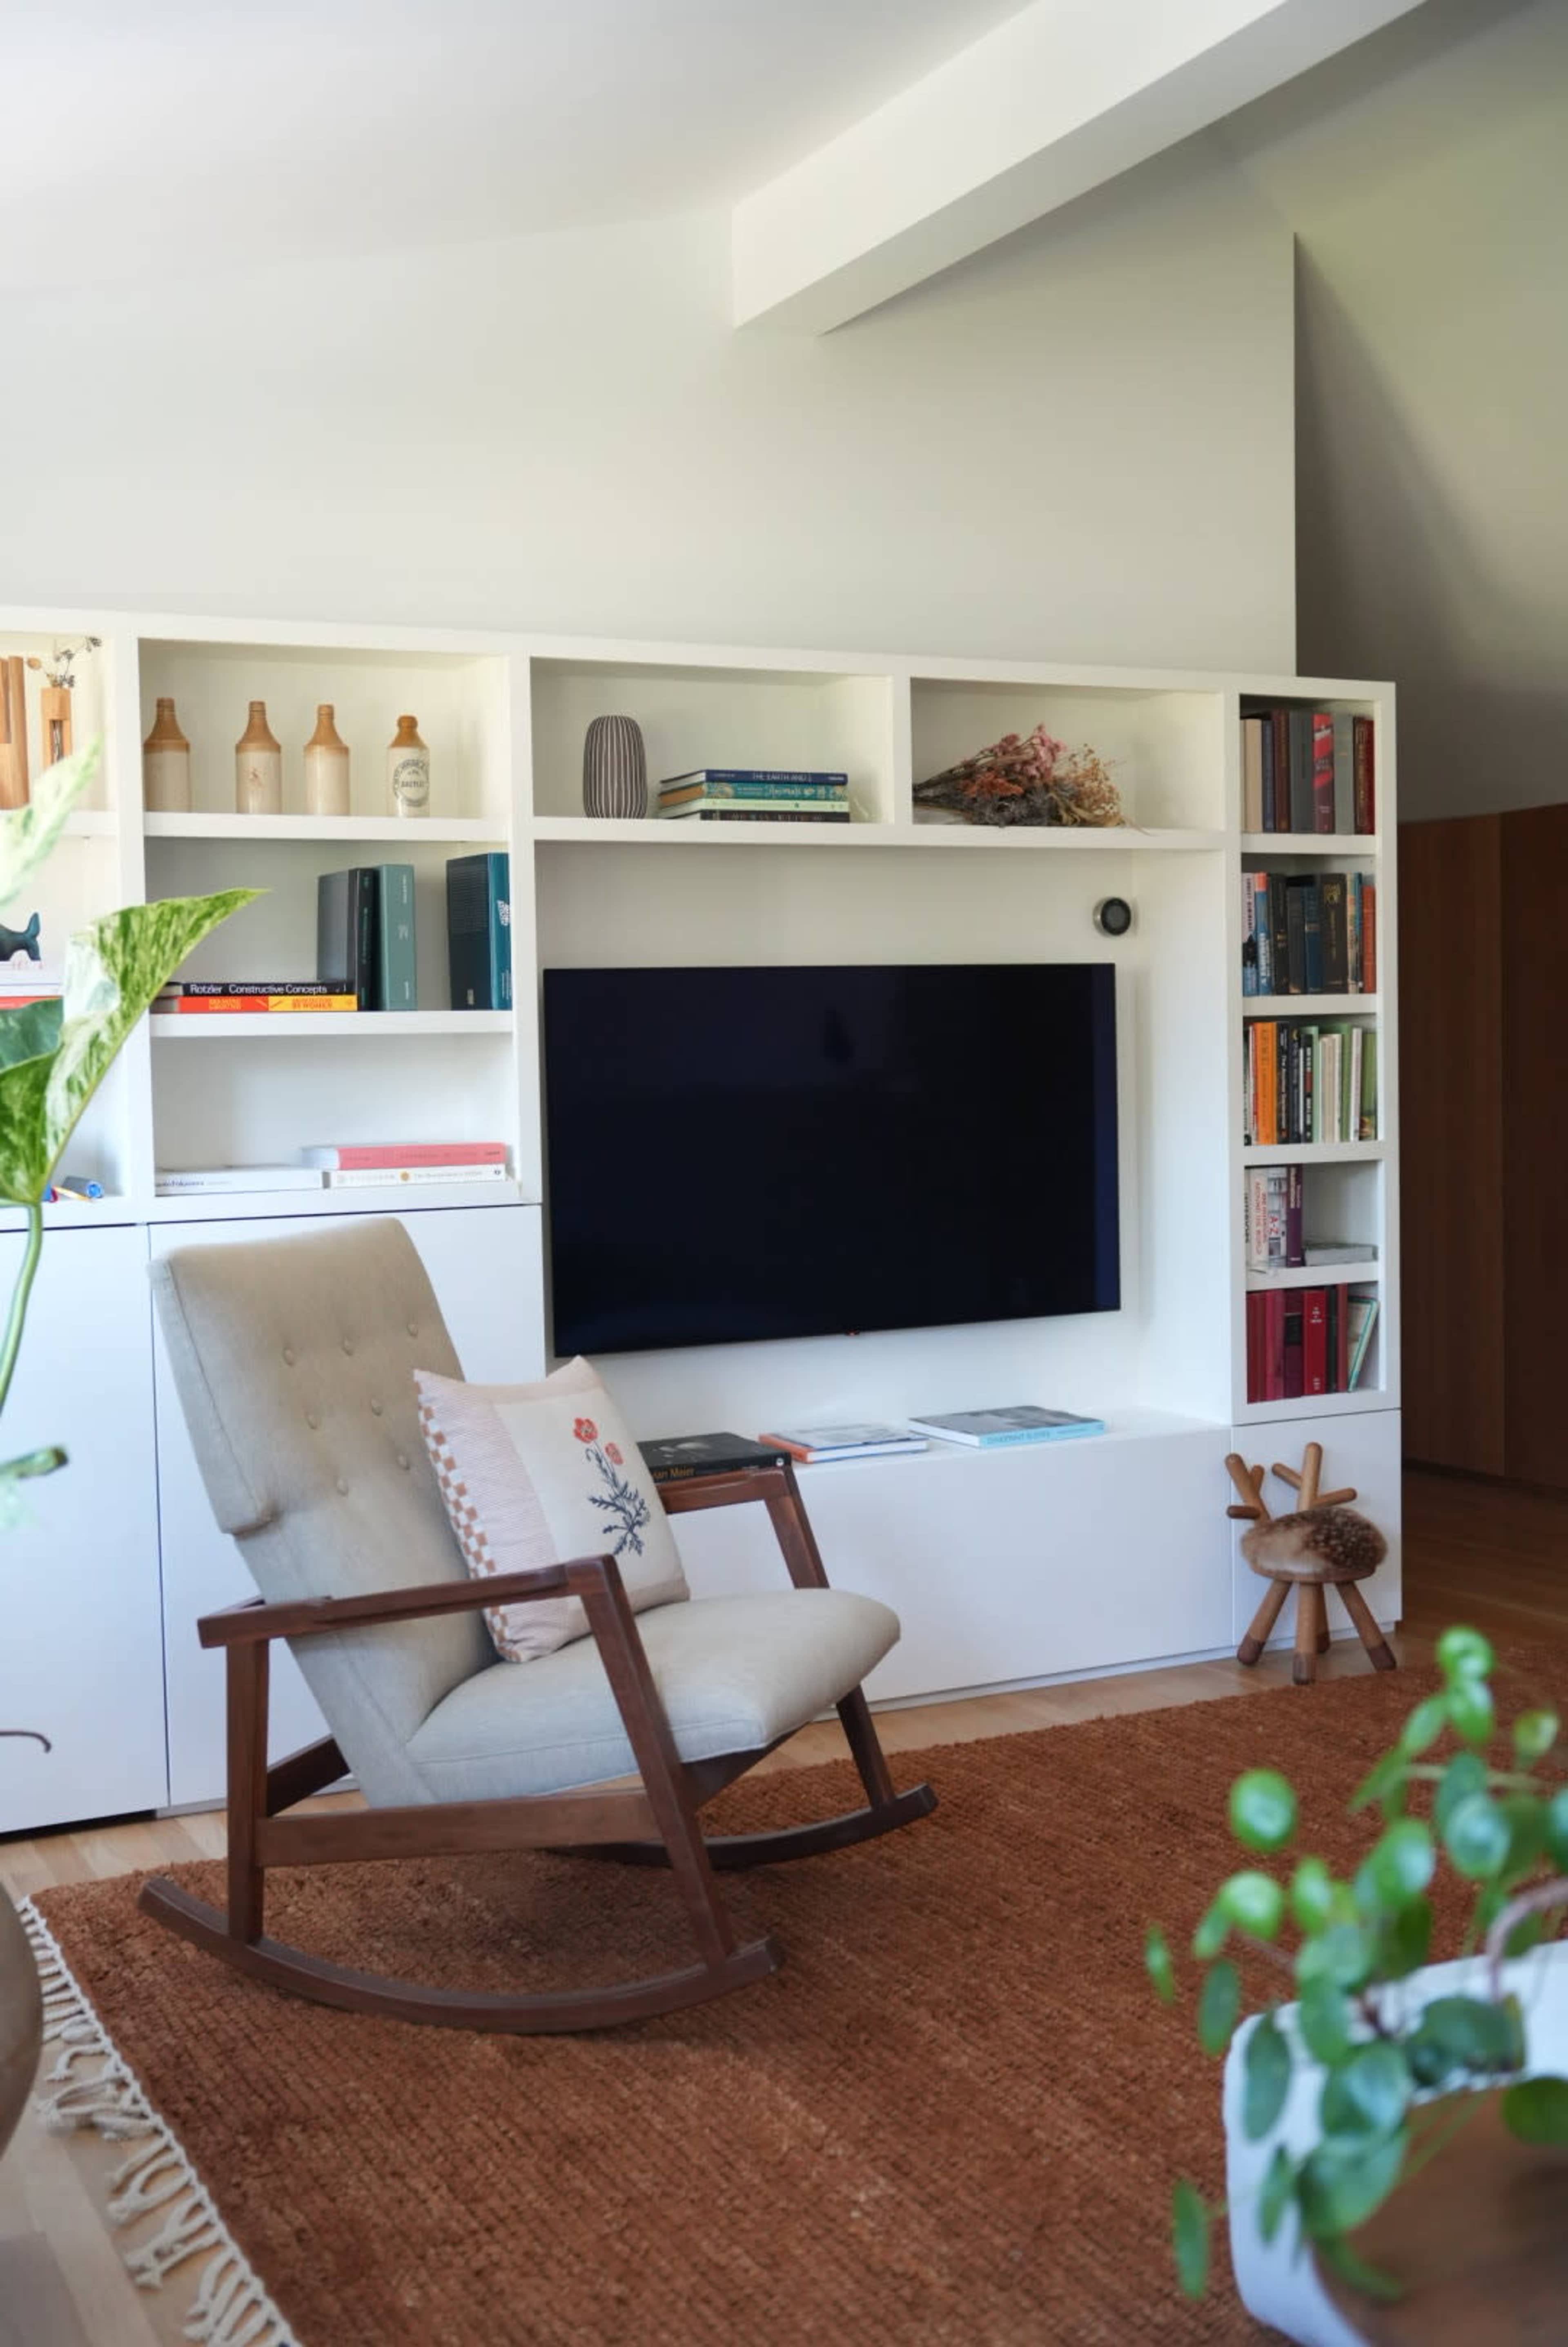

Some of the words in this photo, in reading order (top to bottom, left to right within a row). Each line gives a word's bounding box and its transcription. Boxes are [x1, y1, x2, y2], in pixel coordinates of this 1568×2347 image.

[753, 772, 765, 780] THE
[767, 772, 786, 781] EARTH
[190, 984, 223, 994] Rotzler
[229, 984, 284, 994] Constructive
[286, 984, 327, 995] Concepts
